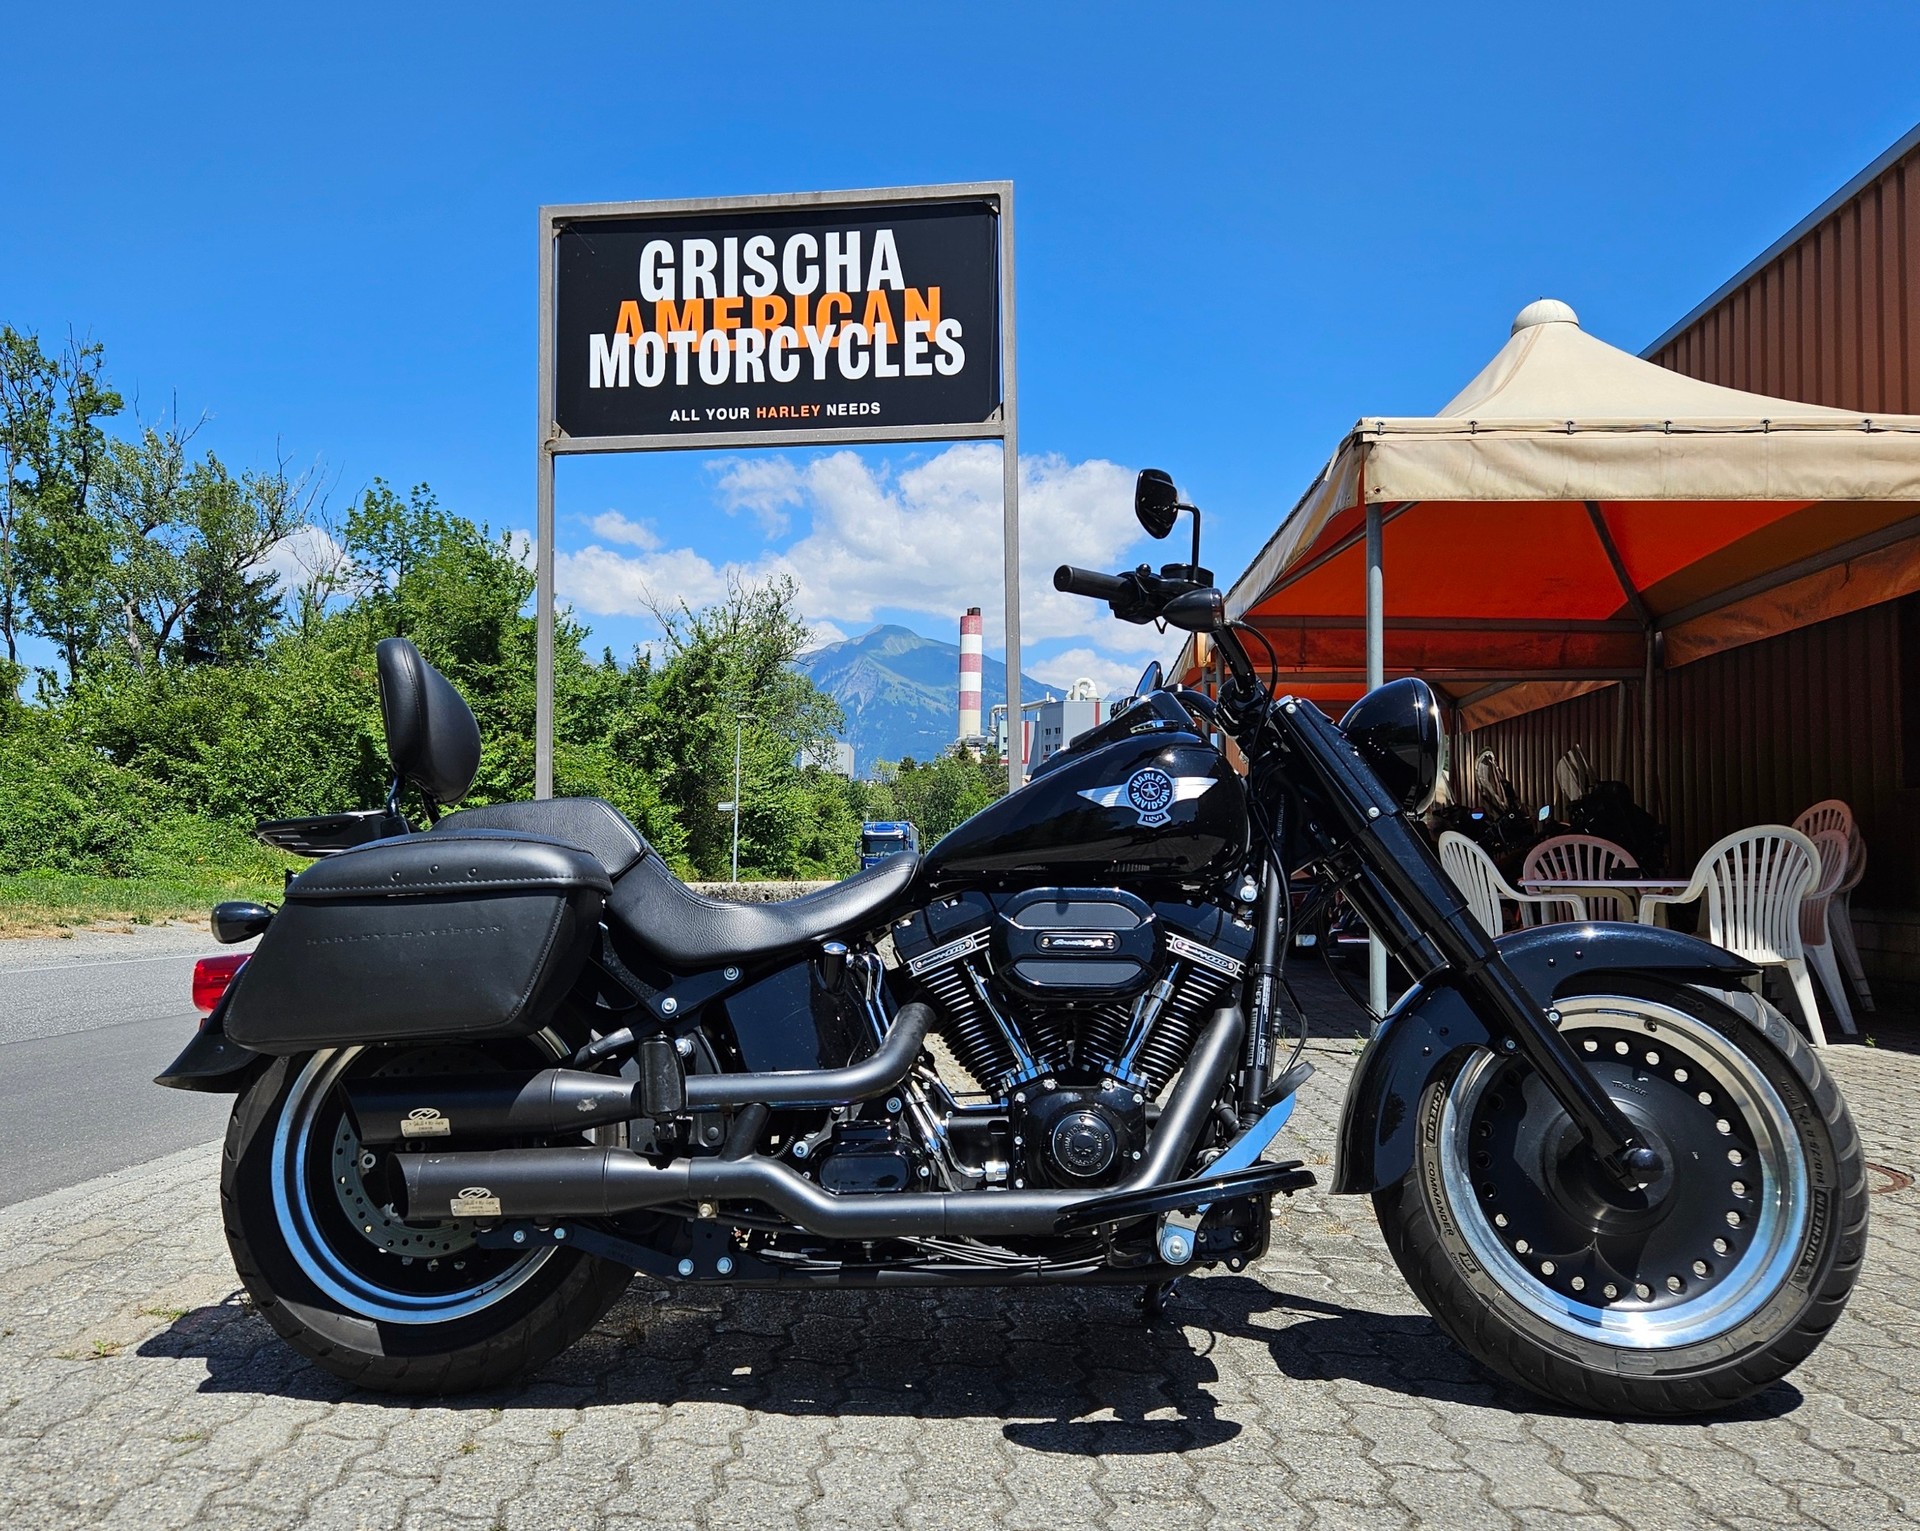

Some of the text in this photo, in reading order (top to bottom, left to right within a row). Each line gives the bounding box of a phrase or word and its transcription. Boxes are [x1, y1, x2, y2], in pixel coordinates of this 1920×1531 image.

[639, 229, 905, 302] GRISCHA
[589, 318, 965, 388] MOTORCYCLES
[615, 286, 942, 355] AMERICAN
[670, 402, 881, 421] ALL YOUR HARLEY NEEDS
[1131, 789, 1170, 810] DAVIDSON
[1132, 773, 1167, 788] HARLEY
[1426, 1076, 1448, 1140] MICHELIN
[1428, 1160, 1455, 1237] COMMANDER
[1805, 1192, 1826, 1263] MICHELIN
